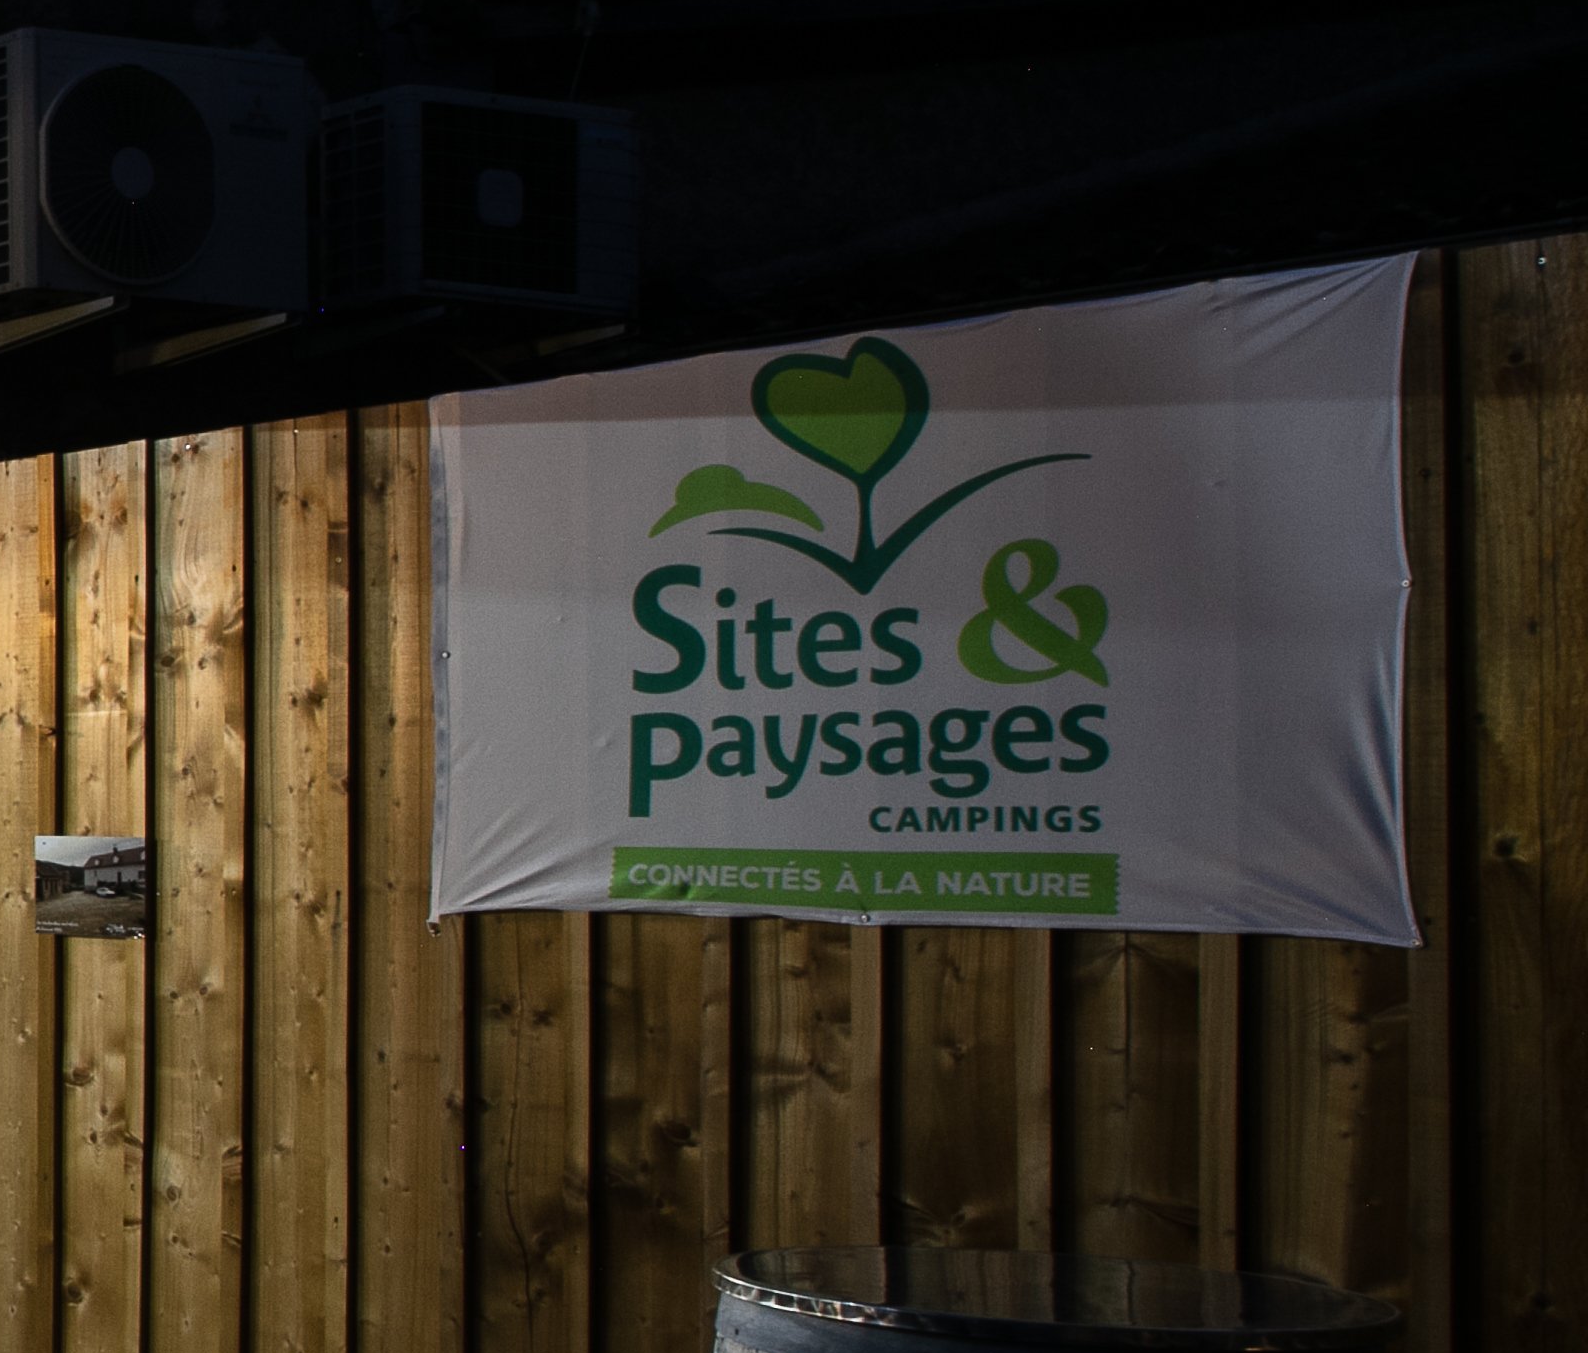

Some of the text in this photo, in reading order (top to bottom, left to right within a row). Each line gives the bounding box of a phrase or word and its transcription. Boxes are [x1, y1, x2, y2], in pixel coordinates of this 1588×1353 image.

[632, 538, 1110, 695] Sites &
[628, 702, 1110, 819] paysages
[869, 805, 1102, 834] CAMPINGS
[627, 859, 1092, 899] CONNECTÉS À LA NATURE
